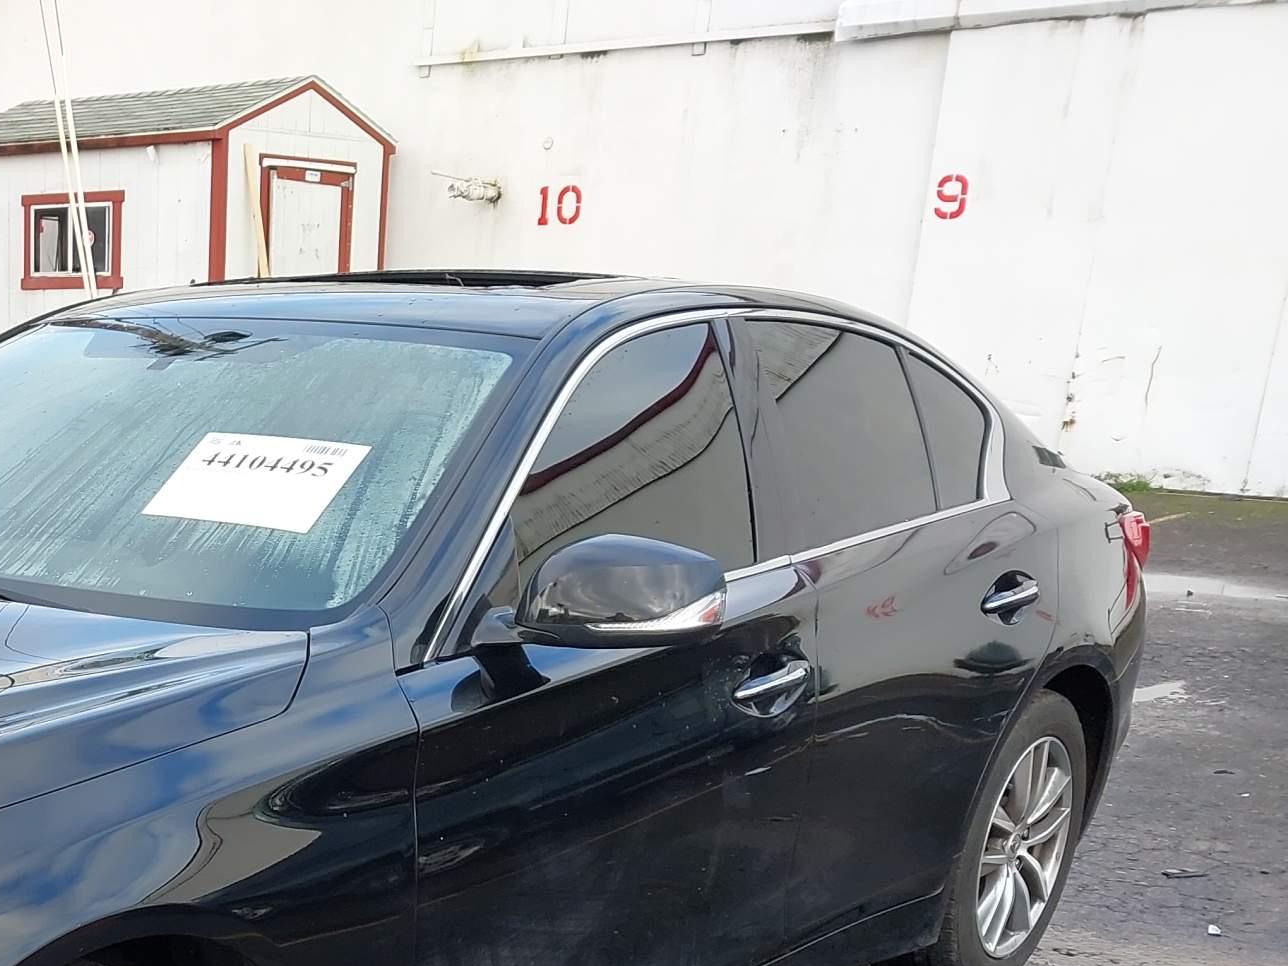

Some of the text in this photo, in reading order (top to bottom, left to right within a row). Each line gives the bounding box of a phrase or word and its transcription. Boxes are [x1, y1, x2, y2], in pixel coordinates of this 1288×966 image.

[537, 185, 582, 226] 10
[933, 174, 969, 220] 9
[202, 451, 334, 478] 44104495
